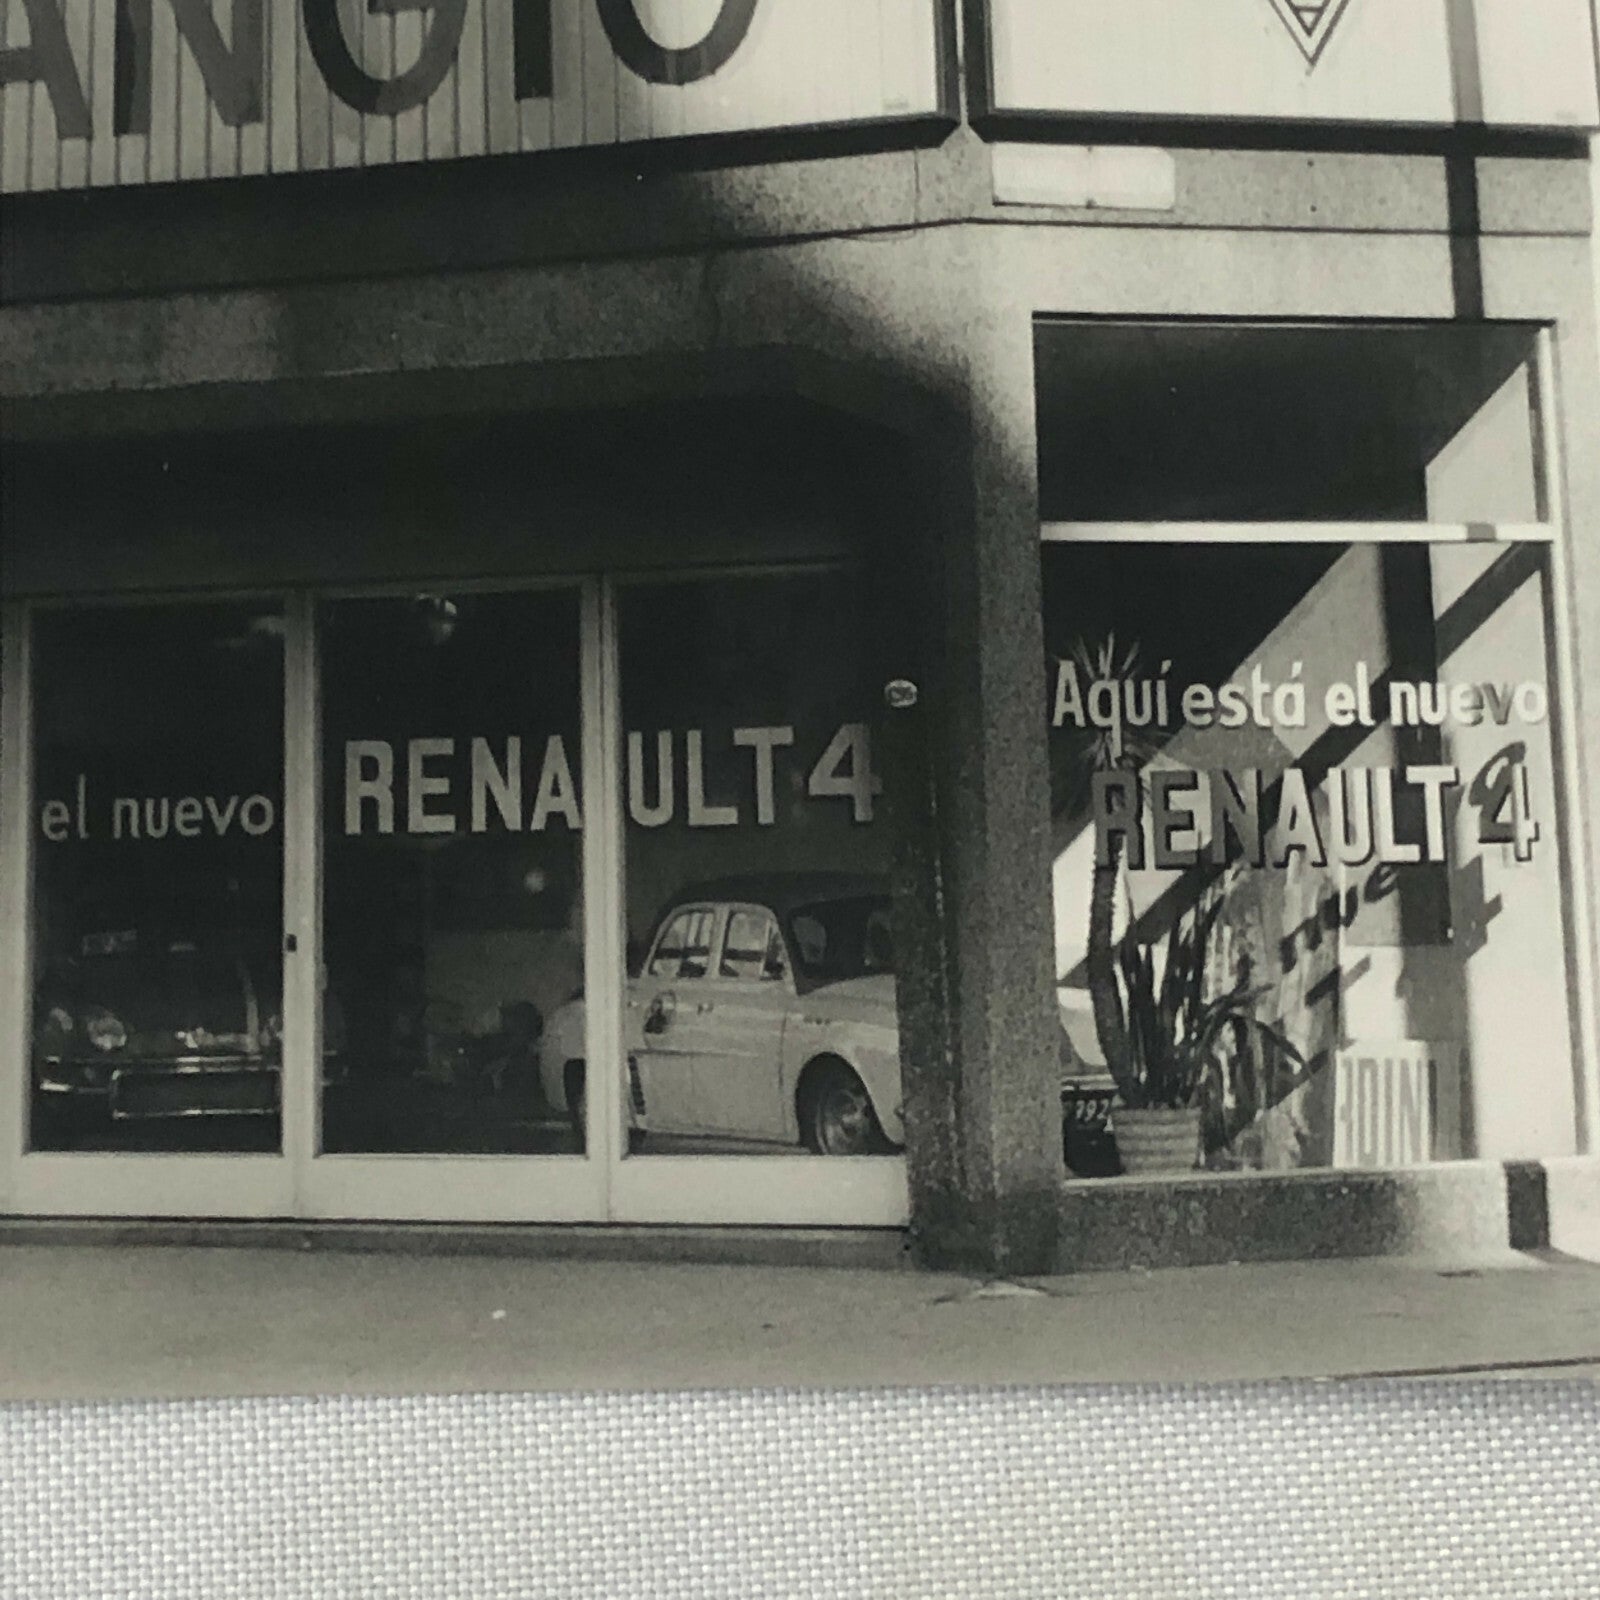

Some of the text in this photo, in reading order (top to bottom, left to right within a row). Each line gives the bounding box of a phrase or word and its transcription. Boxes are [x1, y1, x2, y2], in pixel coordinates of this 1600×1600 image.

[1052, 660, 1547, 758] Aquí está el nuevo
[41, 773, 89, 840] el
[112, 794, 275, 839] nuevo
[808, 723, 883, 823] 4
[1092, 760, 1541, 871] RENAULT 4
